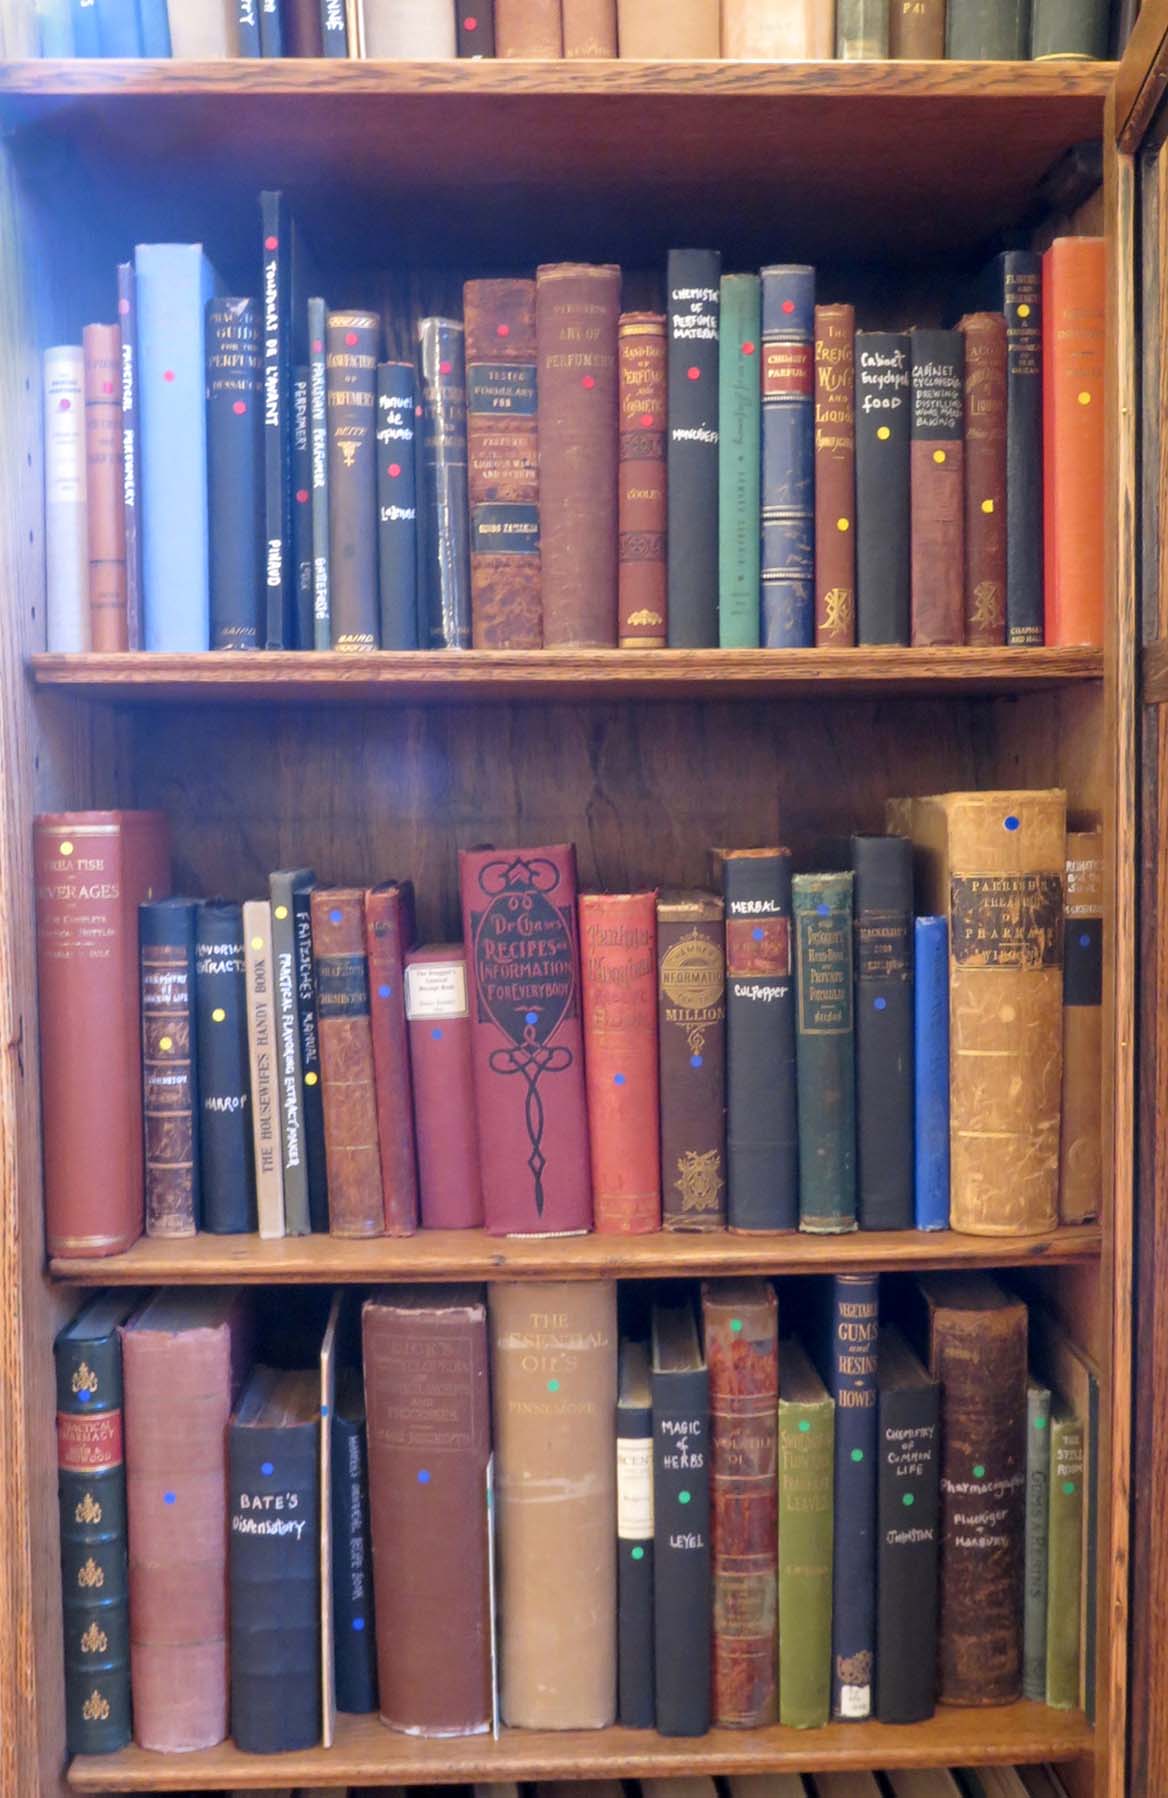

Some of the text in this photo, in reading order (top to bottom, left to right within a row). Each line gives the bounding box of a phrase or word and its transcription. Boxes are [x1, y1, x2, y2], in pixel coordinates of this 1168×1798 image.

[690, 302, 704, 313] OF
[265, 339, 278, 357] DE
[861, 349, 906, 369] Cabinet
[122, 344, 134, 412] PRACTICAL
[912, 362, 954, 378] CABINET
[293, 381, 307, 451] PERFUMERY
[266, 539, 282, 587] PINAUD
[731, 900, 781, 914] HERBAL
[484, 939, 558, 964] RECIPES
[254, 959, 267, 994] BOOK
[480, 961, 571, 982] INFORMATION
[278, 952, 294, 1013] PRACTICAL
[666, 1007, 725, 1021] MILLION
[255, 1000, 269, 1047] HANDY
[260, 1147, 274, 1175] THE
[529, 1313, 568, 1328] THE
[838, 1322, 879, 1341] GUMS
[661, 1420, 701, 1436] MAGIC
[675, 1437, 689, 1451] of
[901, 1441, 914, 1450] of
[663, 1451, 703, 1469] HERBS
[896, 1463, 924, 1476] LIFE
[240, 1492, 299, 1509] BATE'S
[669, 1534, 704, 1549] LEYEL
